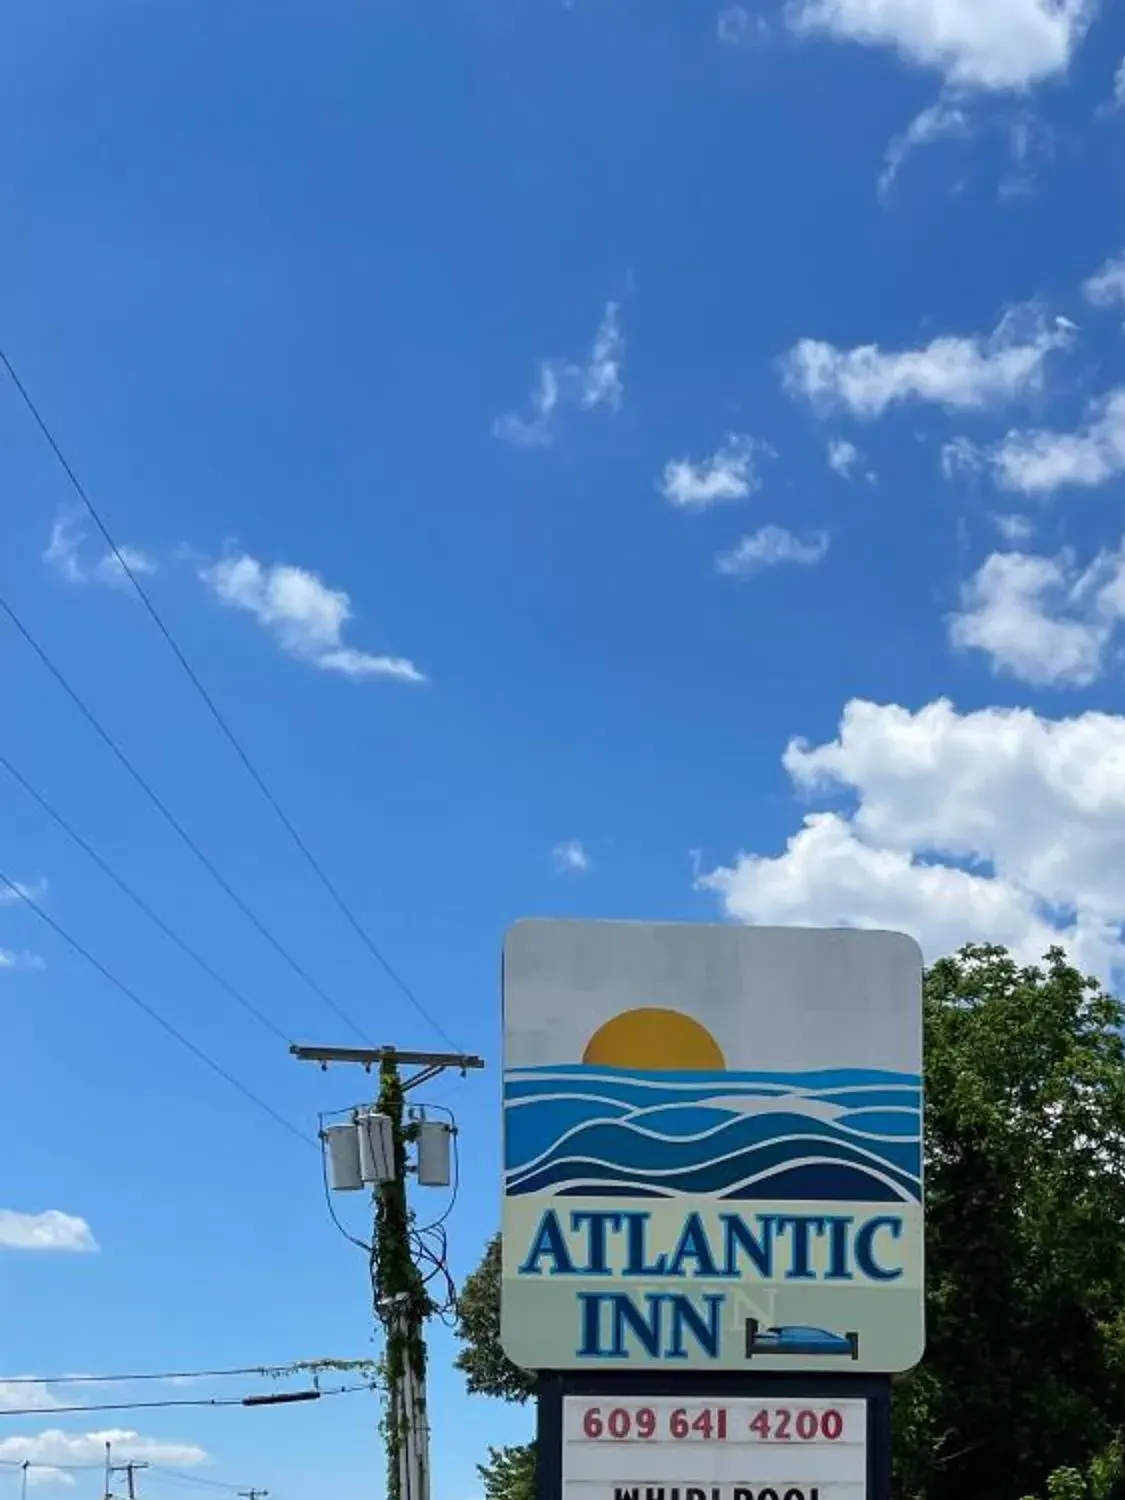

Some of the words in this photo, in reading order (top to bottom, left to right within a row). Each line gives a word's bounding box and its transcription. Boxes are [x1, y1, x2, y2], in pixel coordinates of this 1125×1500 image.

[517, 1208, 904, 1281] ATLANTIC
[575, 1291, 726, 1359] INN
[583, 1407, 656, 1439] 609
[669, 1408, 727, 1440] 641
[749, 1409, 843, 1440] 4200
